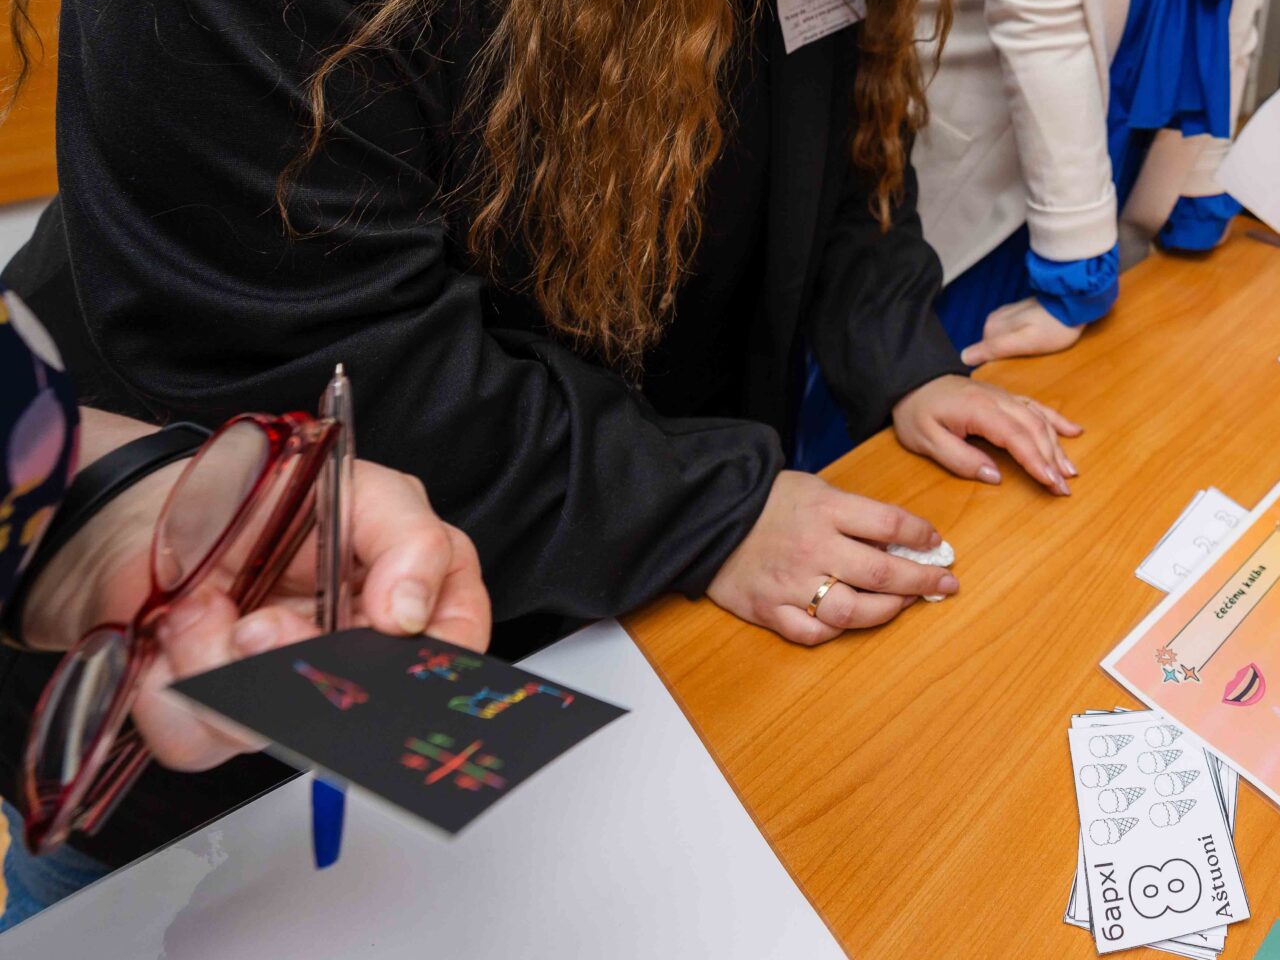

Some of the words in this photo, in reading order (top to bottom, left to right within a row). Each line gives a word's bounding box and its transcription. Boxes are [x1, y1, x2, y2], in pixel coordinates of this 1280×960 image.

[1242, 564, 1267, 589] kalba
[1128, 858, 1202, 919] 8
[1197, 833, 1233, 918] Aštuoni
